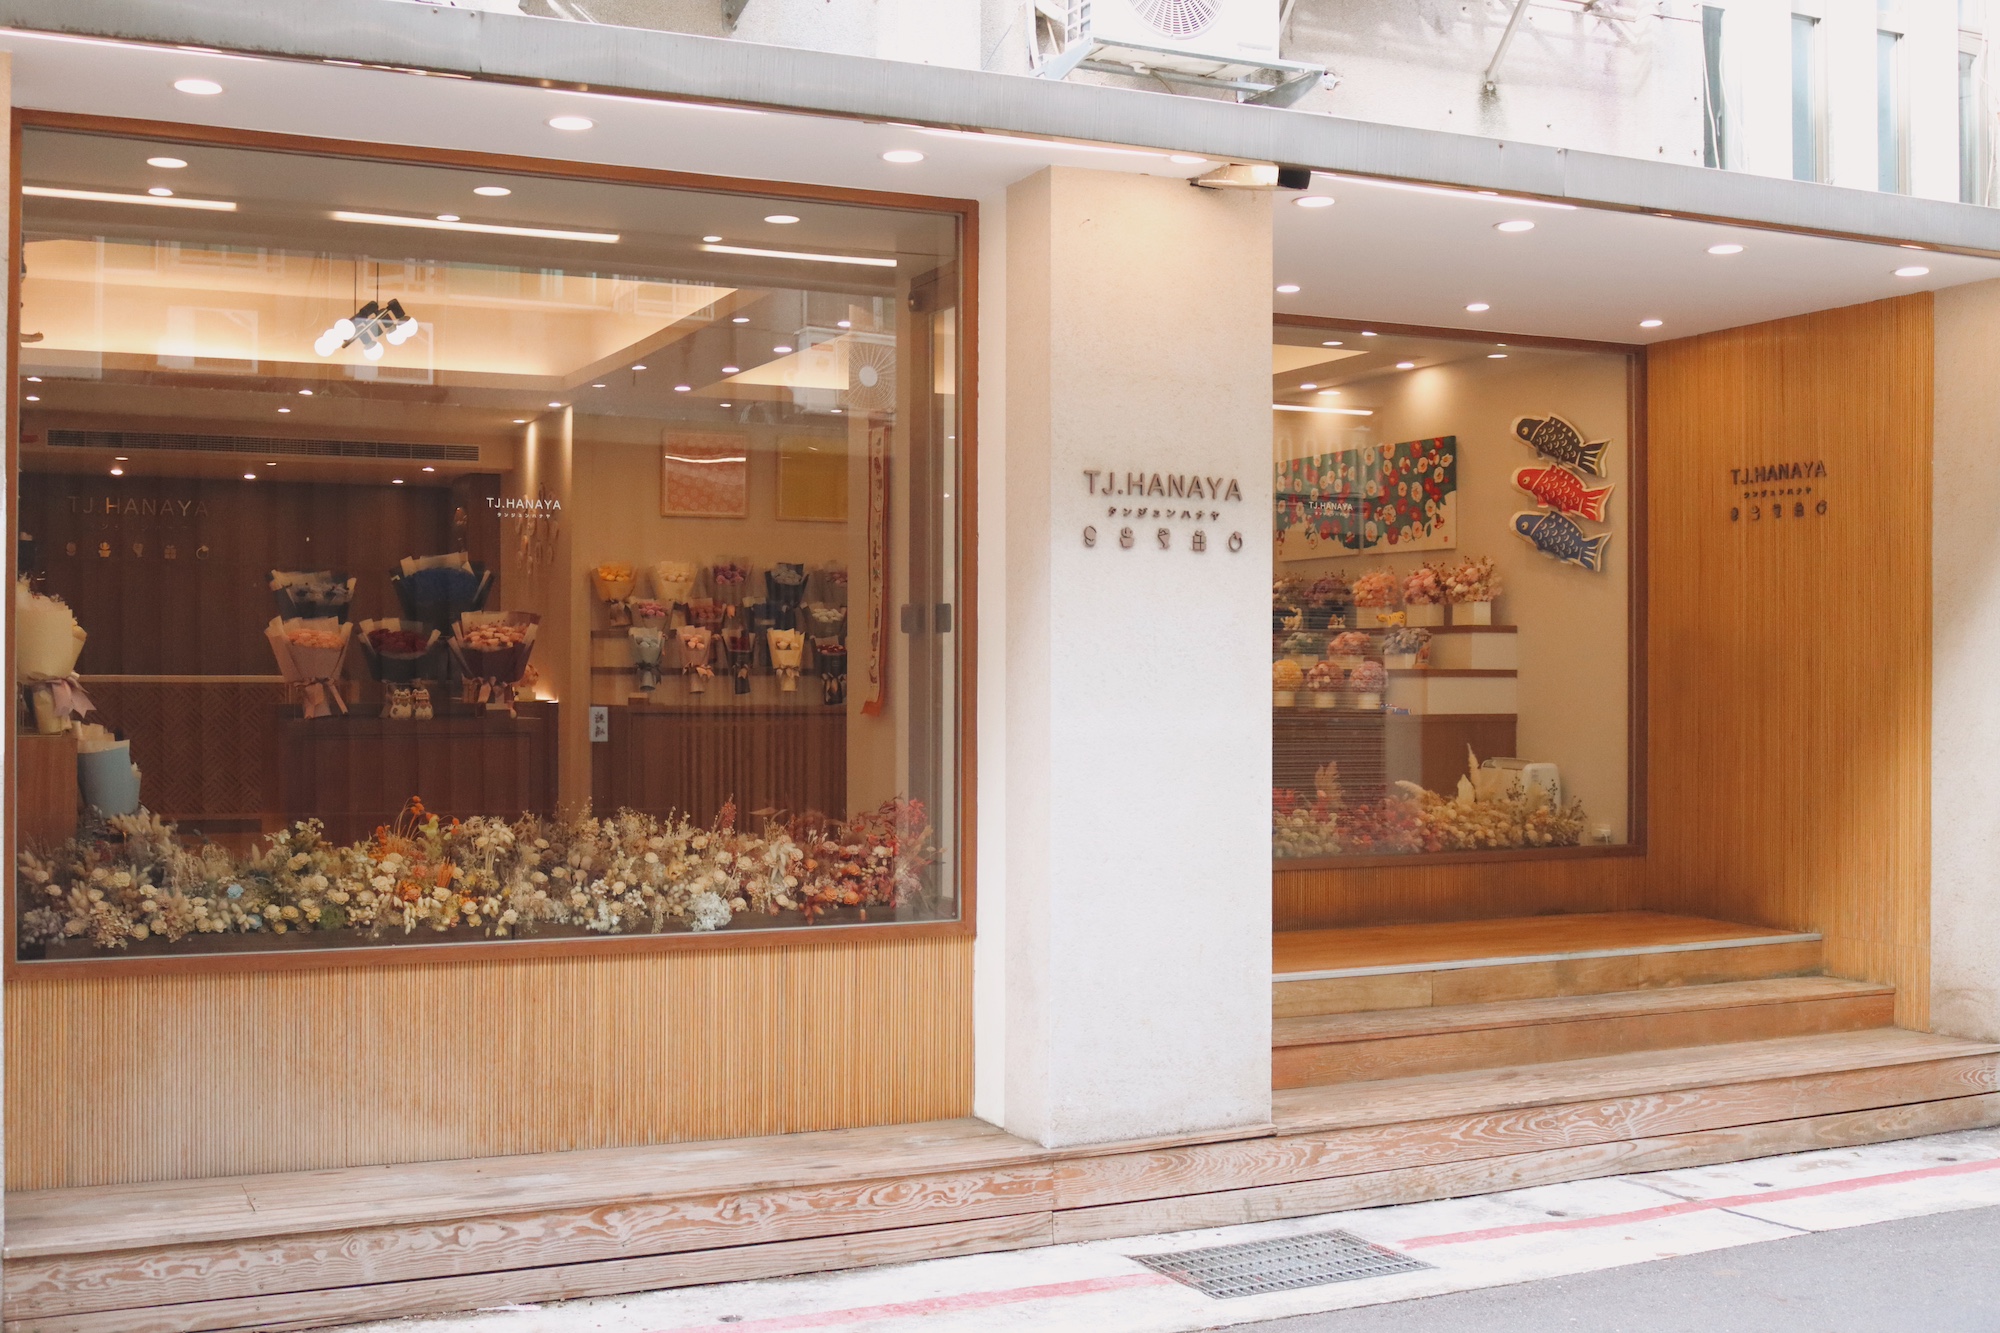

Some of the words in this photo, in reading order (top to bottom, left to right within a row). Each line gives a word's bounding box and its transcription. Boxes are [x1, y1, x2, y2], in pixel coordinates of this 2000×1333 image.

[1730, 459, 1828, 485] TJ.HANAYA
[1083, 469, 1243, 502] TJ.HANAYA
[486, 497, 562, 510] TJ.HANAYA
